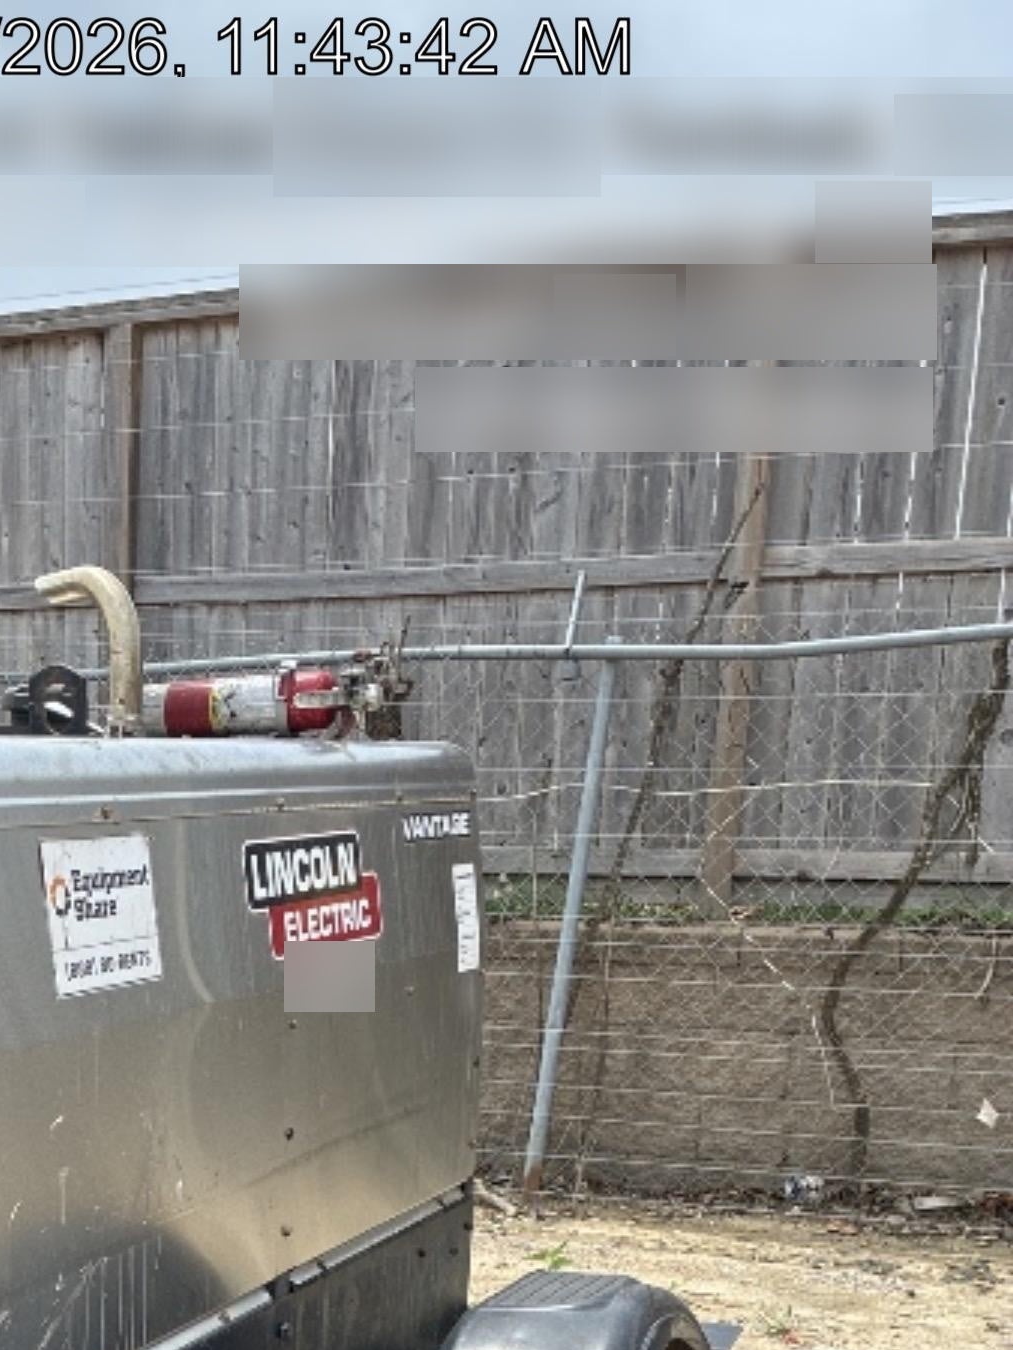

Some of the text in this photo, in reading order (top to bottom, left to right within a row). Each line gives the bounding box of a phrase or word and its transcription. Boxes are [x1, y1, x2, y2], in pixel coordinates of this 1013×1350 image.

[402, 811, 470, 841] VANTAGE
[70, 864, 150, 897] Equipment
[250, 842, 357, 900] LINCOLN
[73, 897, 117, 922] Share
[283, 898, 372, 942] ELECTRIC
